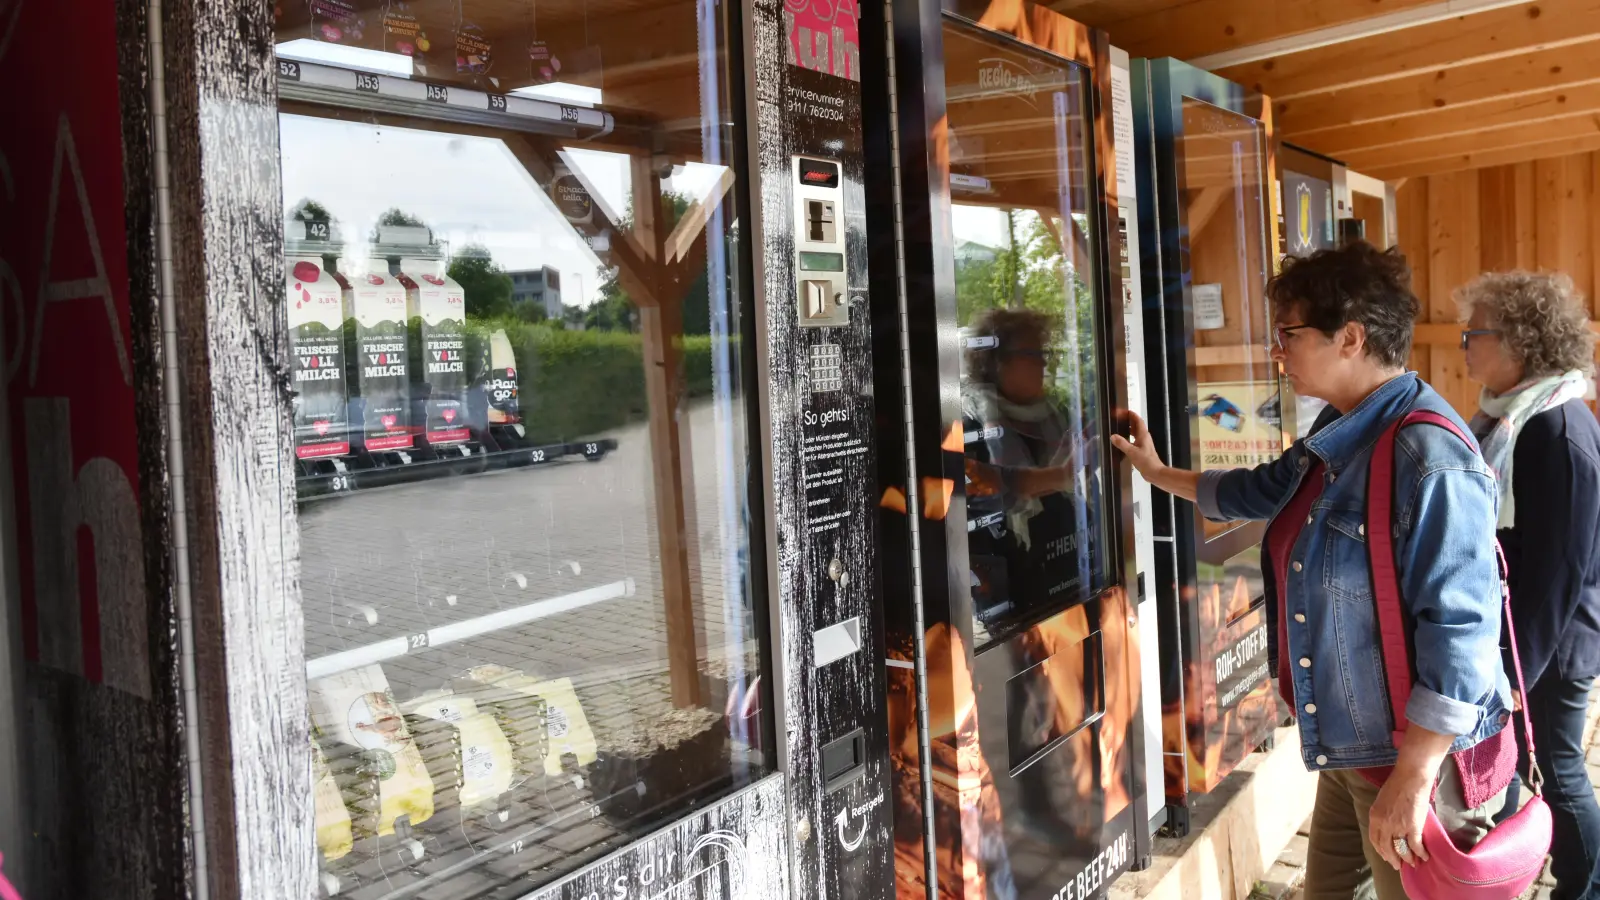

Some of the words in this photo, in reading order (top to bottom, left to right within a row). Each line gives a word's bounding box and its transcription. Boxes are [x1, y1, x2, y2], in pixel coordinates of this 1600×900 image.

[357, 75, 379, 91] A53
[428, 85, 448, 100] A54
[787, 86, 845, 107] ervicenummer
[491, 95, 505, 108] 55
[562, 107, 579, 121] A56
[809, 105, 844, 122] 7620304
[310, 223, 327, 237] 42
[294, 345, 339, 355] FRISCHE
[363, 343, 405, 353] FRISCHE
[427, 341, 464, 349] FRISCHE
[295, 368, 341, 381] MILCH
[364, 365, 406, 378] MILCH
[428, 362, 464, 373] MILCH
[804, 410, 818, 426] So
[820, 407, 850, 428] gehts!
[586, 442, 598, 454] 33
[532, 450, 545, 463] 32
[332, 476, 348, 490] 31
[411, 633, 427, 649] 22
[1215, 629, 1259, 684] ROH-STOFF
[1259, 623, 1268, 651] BE
[589, 805, 601, 819] 13
[851, 792, 885, 820] Restgeld
[510, 840, 524, 855] 12
[639, 850, 678, 886] dir
[1076, 850, 1105, 900] BEEF
[1105, 832, 1127, 879] 24H
